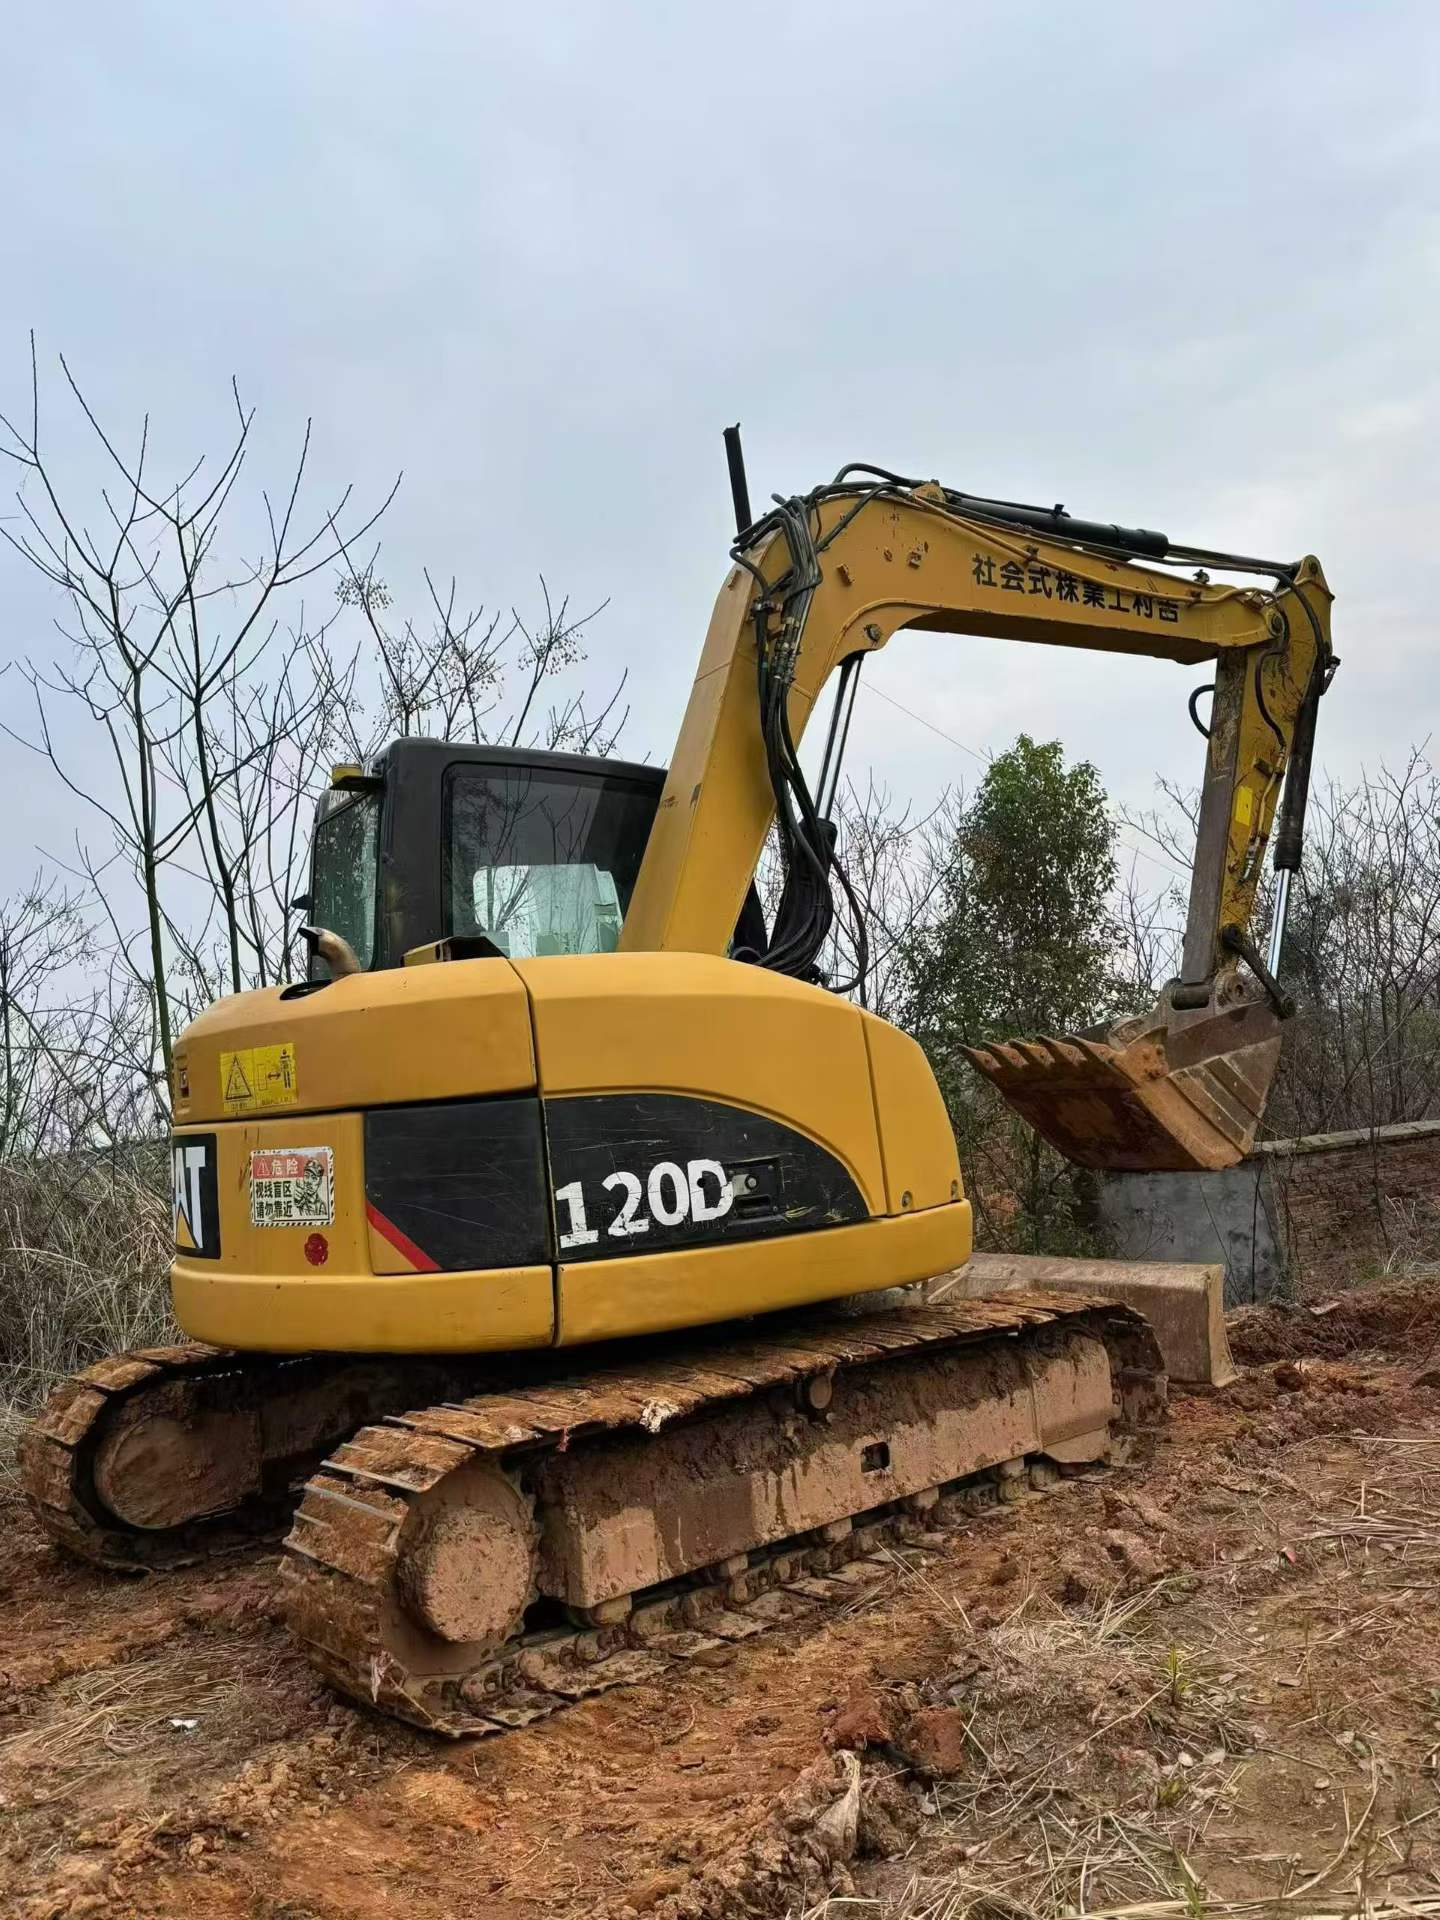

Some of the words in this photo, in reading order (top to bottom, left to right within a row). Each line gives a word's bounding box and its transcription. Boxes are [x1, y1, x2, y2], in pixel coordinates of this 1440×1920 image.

[271, 1157, 299, 1176] 危险
[171, 1146, 206, 1249] AT
[255, 1180, 293, 1199] 视线盲区
[255, 1200, 293, 1219] 请勿靠近
[555, 1159, 734, 1249] 120D
